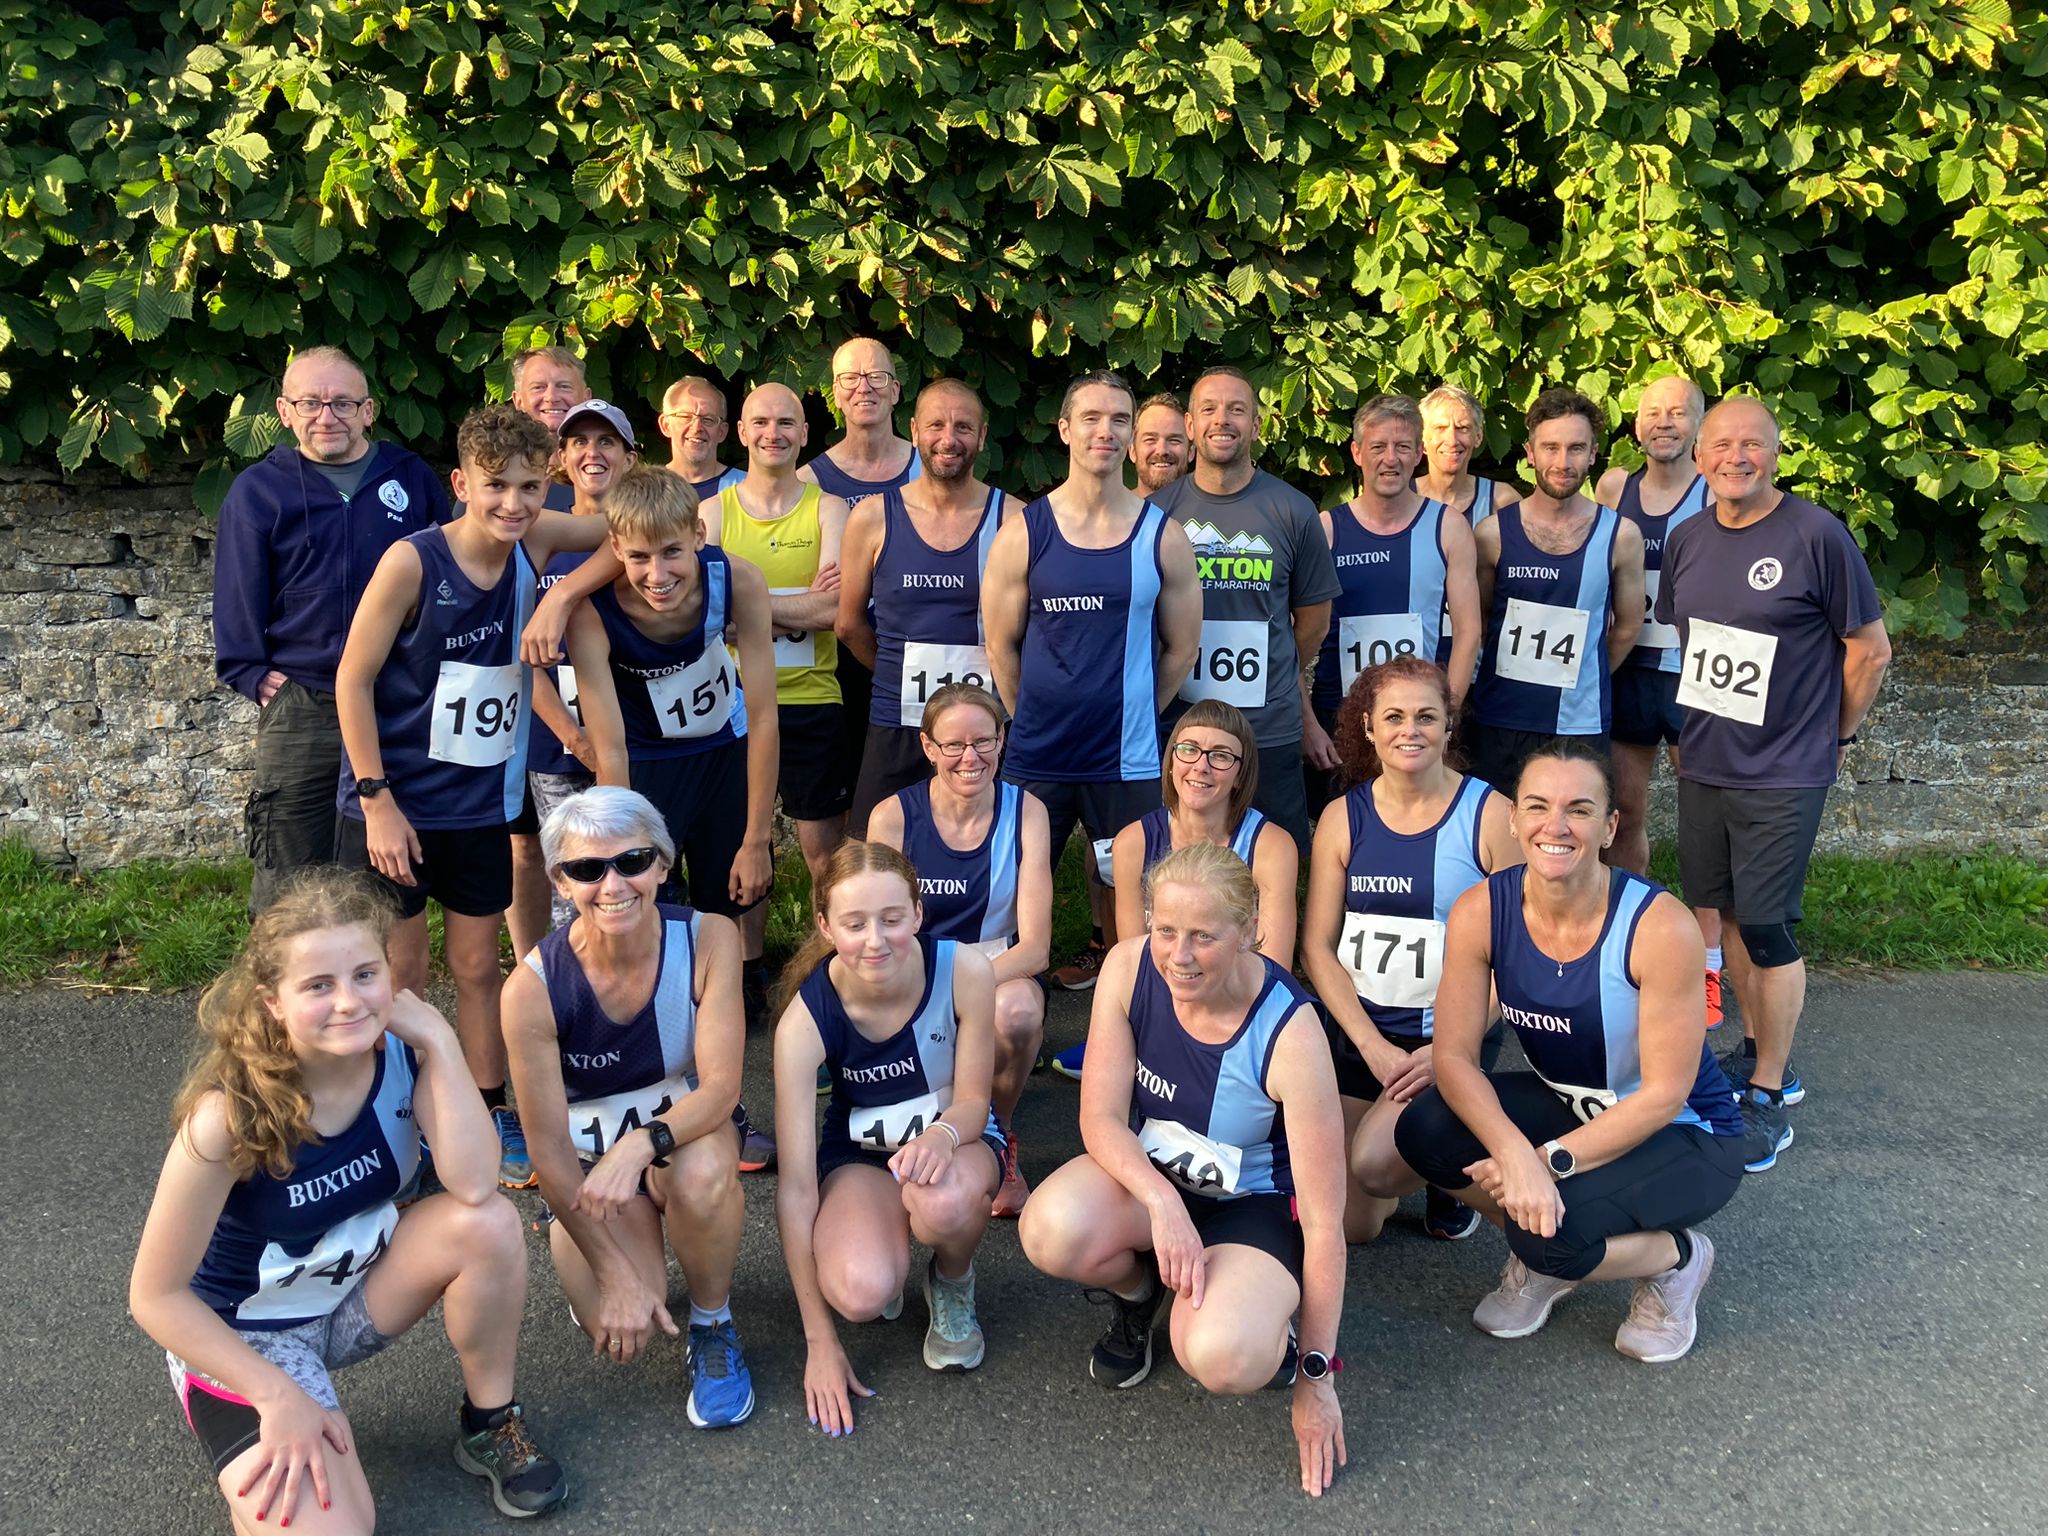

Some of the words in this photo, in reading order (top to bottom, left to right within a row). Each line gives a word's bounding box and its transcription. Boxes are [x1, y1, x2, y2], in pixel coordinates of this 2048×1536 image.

[1196, 557, 1274, 581] XTON
[1336, 550, 1391, 568] BUXTON
[902, 574, 965, 589] BUXTON
[1507, 566, 1560, 581] BUXTON
[1201, 580, 1213, 590] LF
[1214, 580, 1271, 592] MARATHON
[1042, 595, 1104, 612] BUXTON
[1508, 625, 1575, 665] 114
[1692, 648, 1762, 698] 192
[666, 665, 730, 728] 151
[445, 692, 519, 738] 193
[916, 878, 968, 895] UXTON
[1350, 875, 1413, 894] BUXTON
[1349, 929, 1427, 979] 171
[563, 1050, 621, 1070] XTON
[1135, 1057, 1178, 1103] XTON
[286, 1147, 382, 1208] BUXTON
